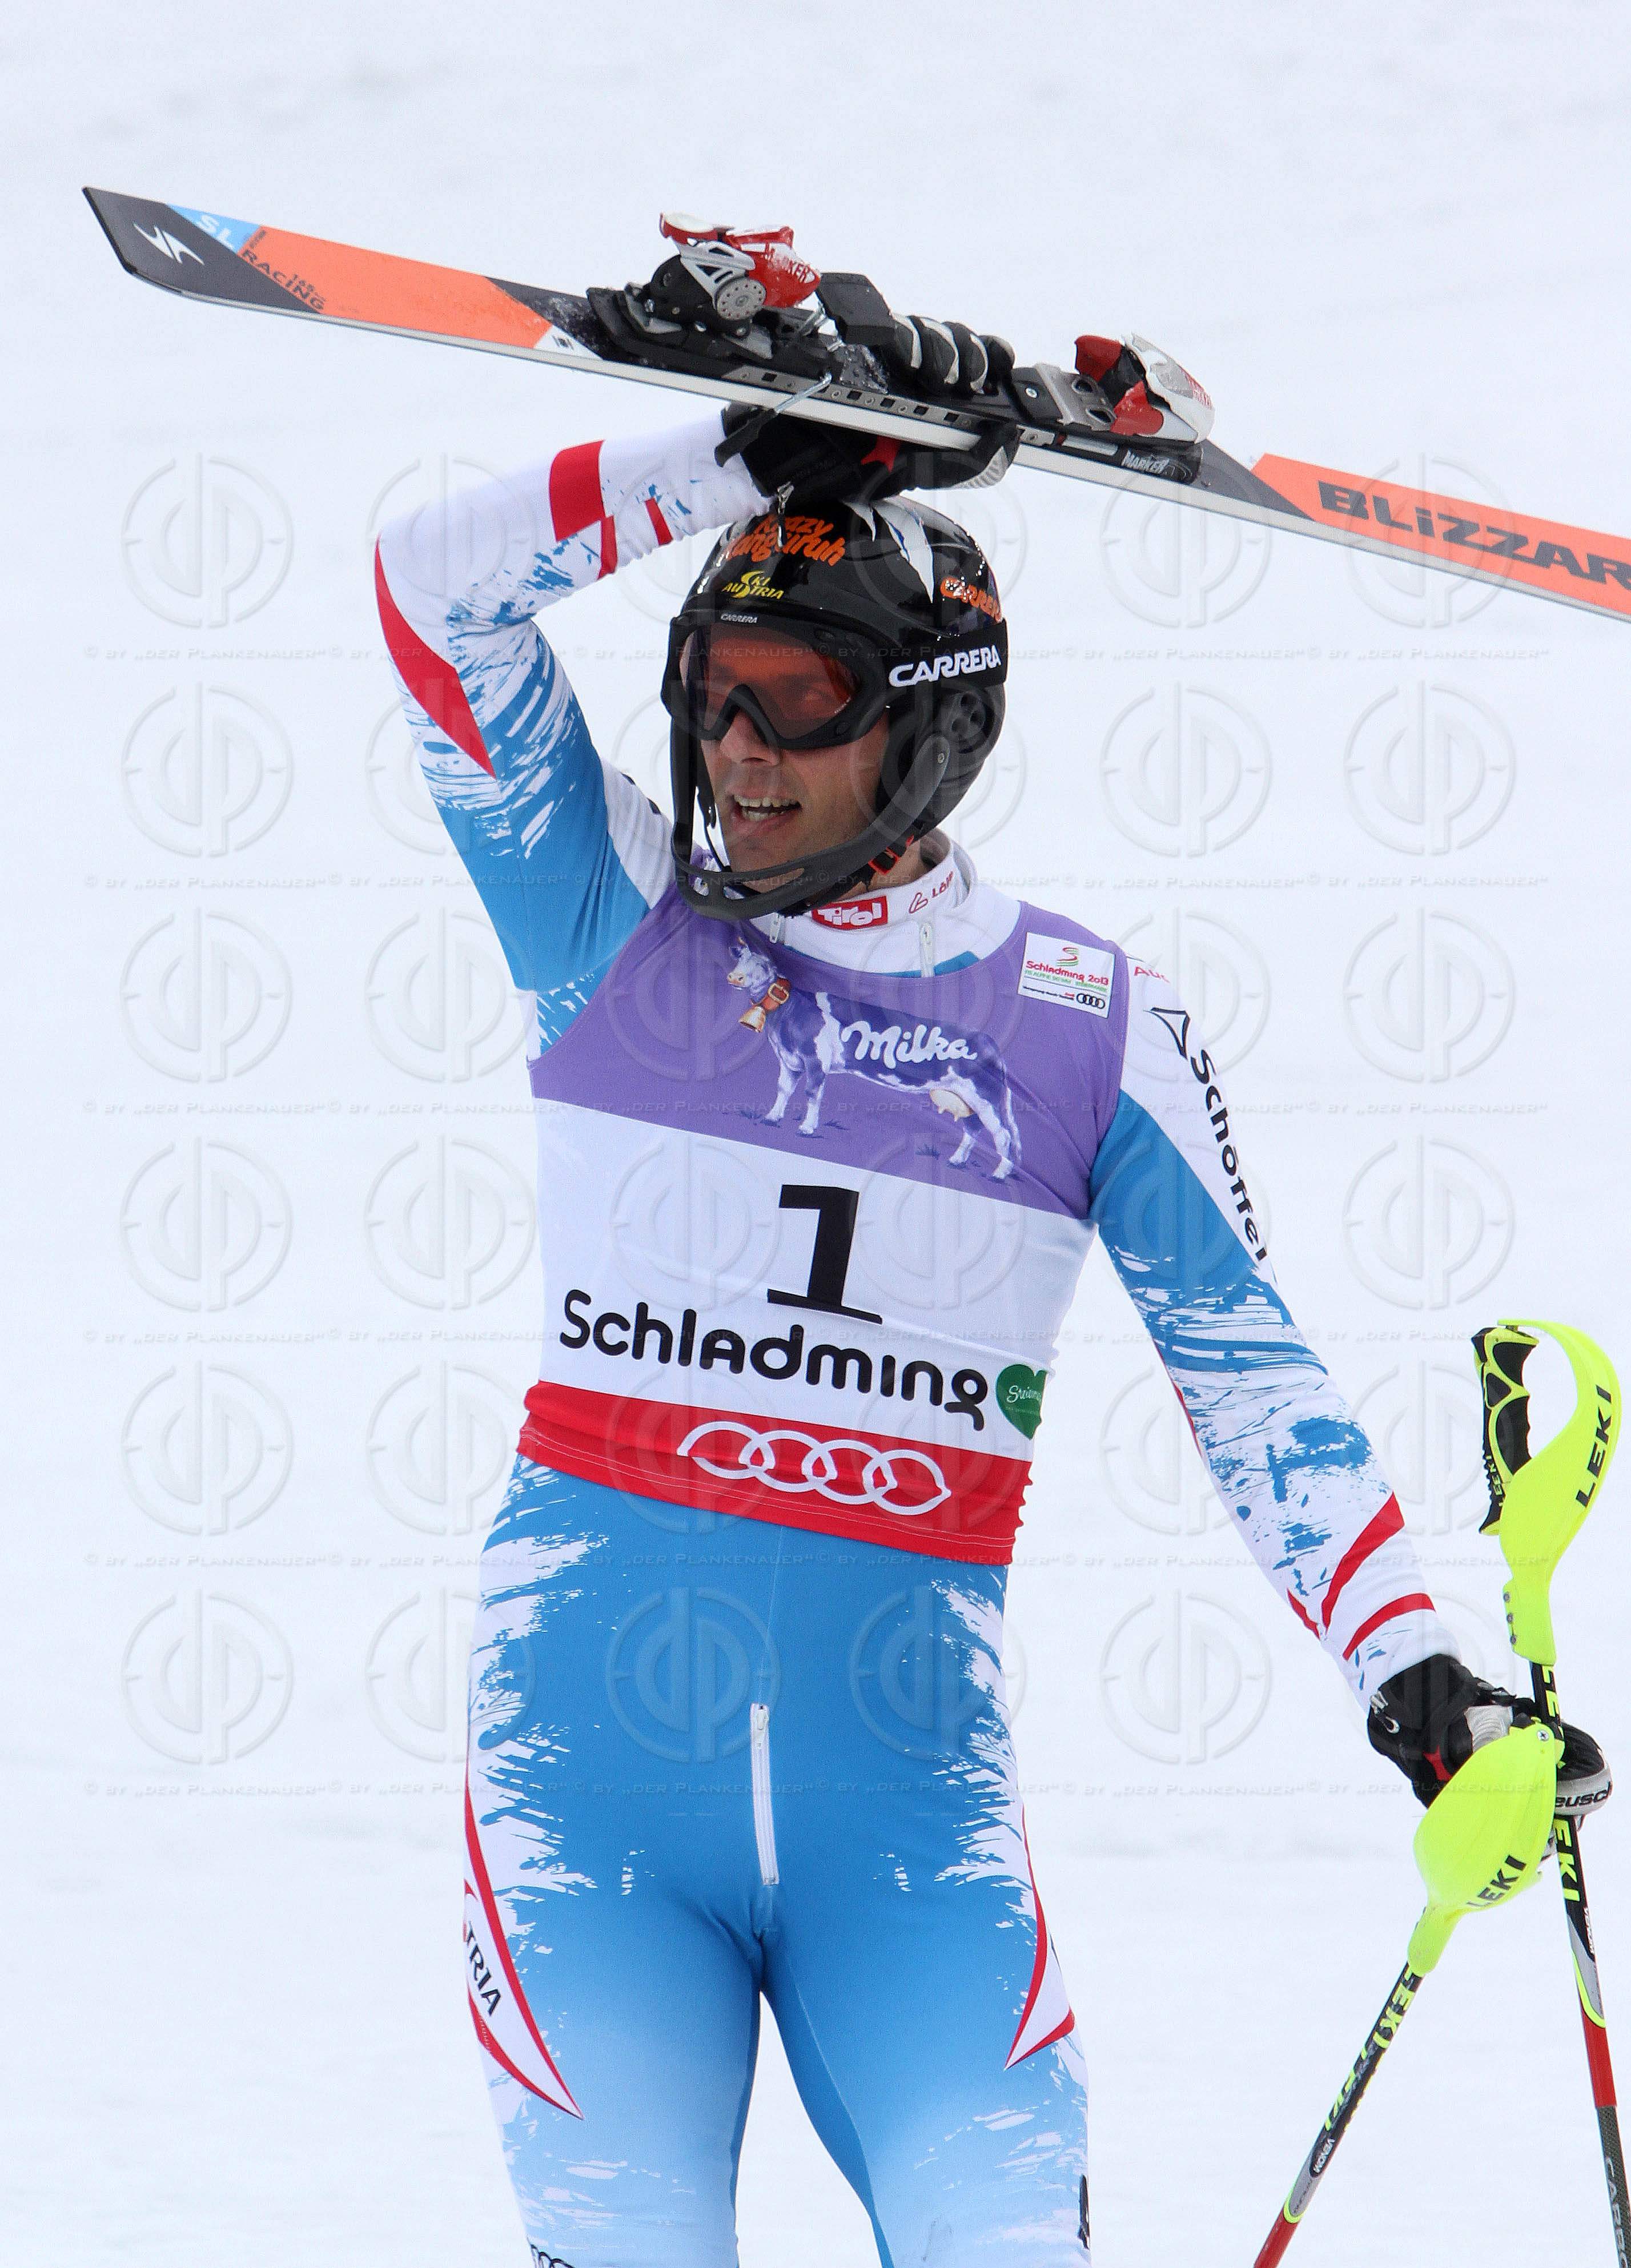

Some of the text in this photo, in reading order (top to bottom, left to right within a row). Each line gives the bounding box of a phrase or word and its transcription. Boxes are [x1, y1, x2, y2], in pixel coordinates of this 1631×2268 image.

[242, 248, 326, 309] RACING
[720, 612, 758, 624] CARRERA
[889, 645, 1002, 687] CARRERA
[1026, 960, 1085, 983] Schladming
[1087, 974, 1109, 986] 2013
[842, 1020, 978, 1069] Milka
[766, 1184, 883, 1325] 1
[560, 1289, 989, 1431] Schladming
[1575, 1385, 1612, 1509] LEKI
[1466, 1854, 1527, 1908] LEKI
[1553, 1818, 1581, 1902] EKI
